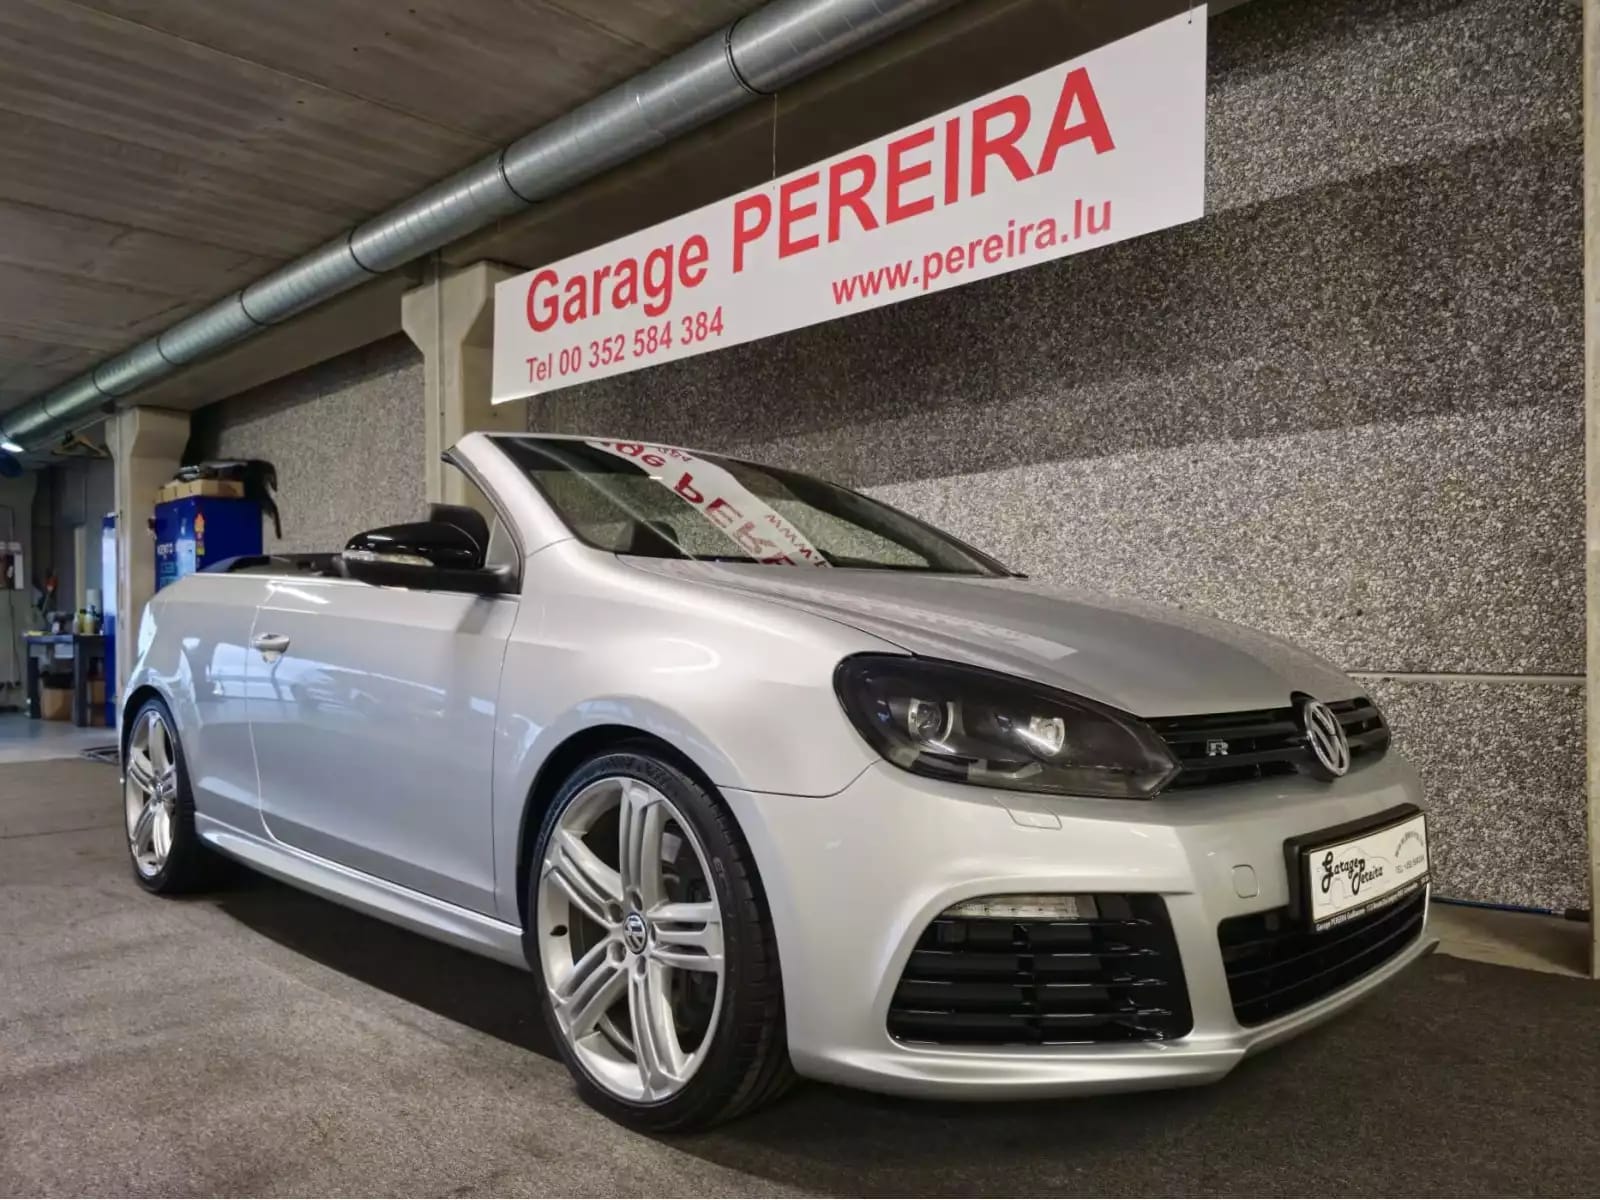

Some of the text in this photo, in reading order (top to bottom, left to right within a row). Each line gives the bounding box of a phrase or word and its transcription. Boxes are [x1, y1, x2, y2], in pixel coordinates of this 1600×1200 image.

[526, 66, 1116, 334] Garage PEREIRA
[832, 198, 1112, 305] www.pereira.lu
[526, 305, 724, 382] Tel 00 352 584 384
[1321, 850, 1360, 894] Garage
